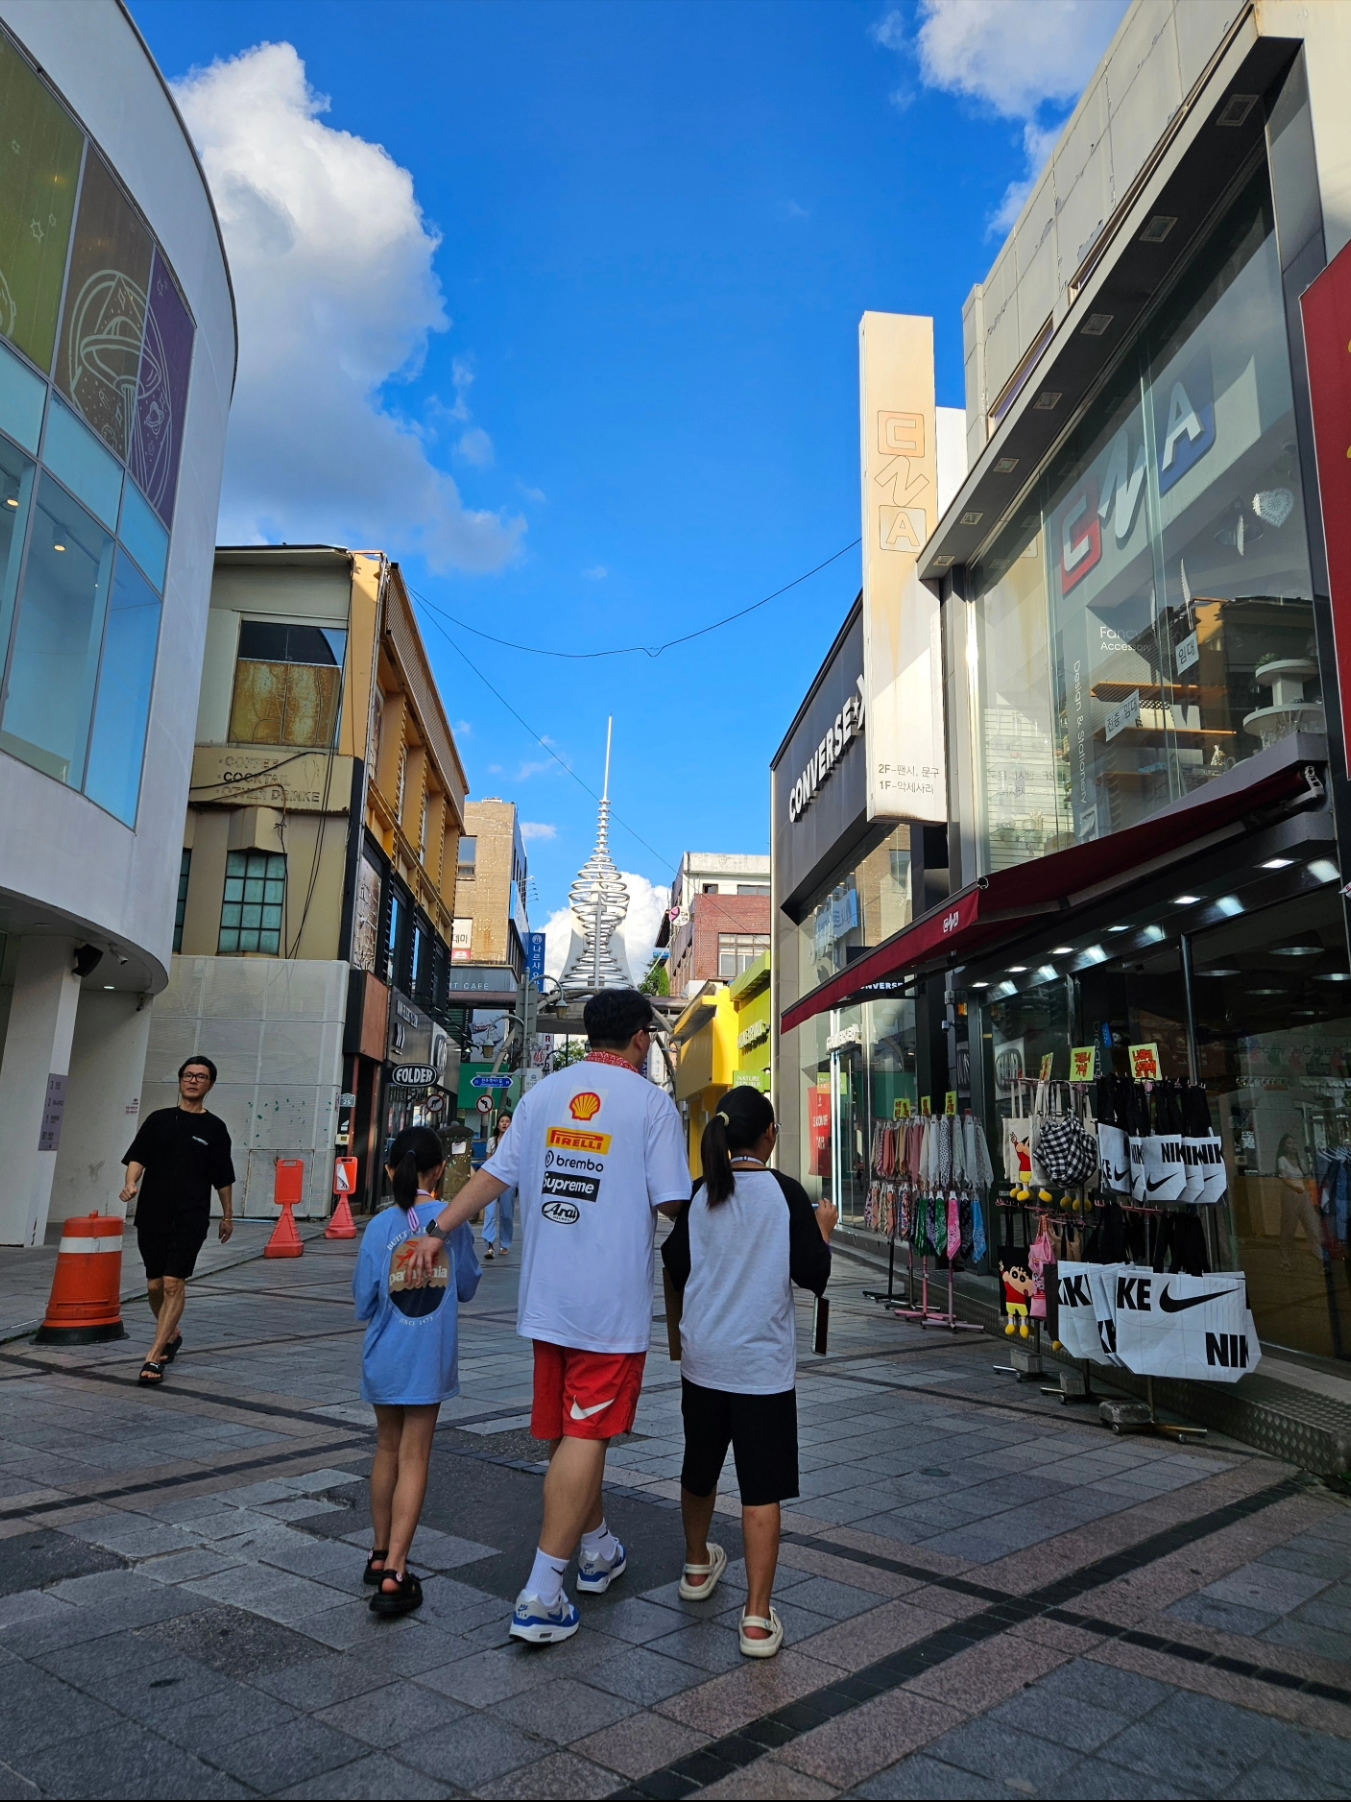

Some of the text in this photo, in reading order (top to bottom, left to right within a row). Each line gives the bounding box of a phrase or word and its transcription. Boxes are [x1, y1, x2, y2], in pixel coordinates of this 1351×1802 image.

[1100, 641, 1151, 653] Accessory
[1178, 639, 1195, 664] 임대
[1123, 695, 1137, 719] 임대
[1073, 660, 1087, 805] Design & Stationery
[789, 697, 855, 822] CONVERSE
[396, 1067, 433, 1084] FOLDER
[550, 1129, 604, 1150] PIRELLI
[556, 1155, 604, 1173] brembo
[543, 1203, 577, 1219] Arai
[386, 1230, 408, 1251] BUILT
